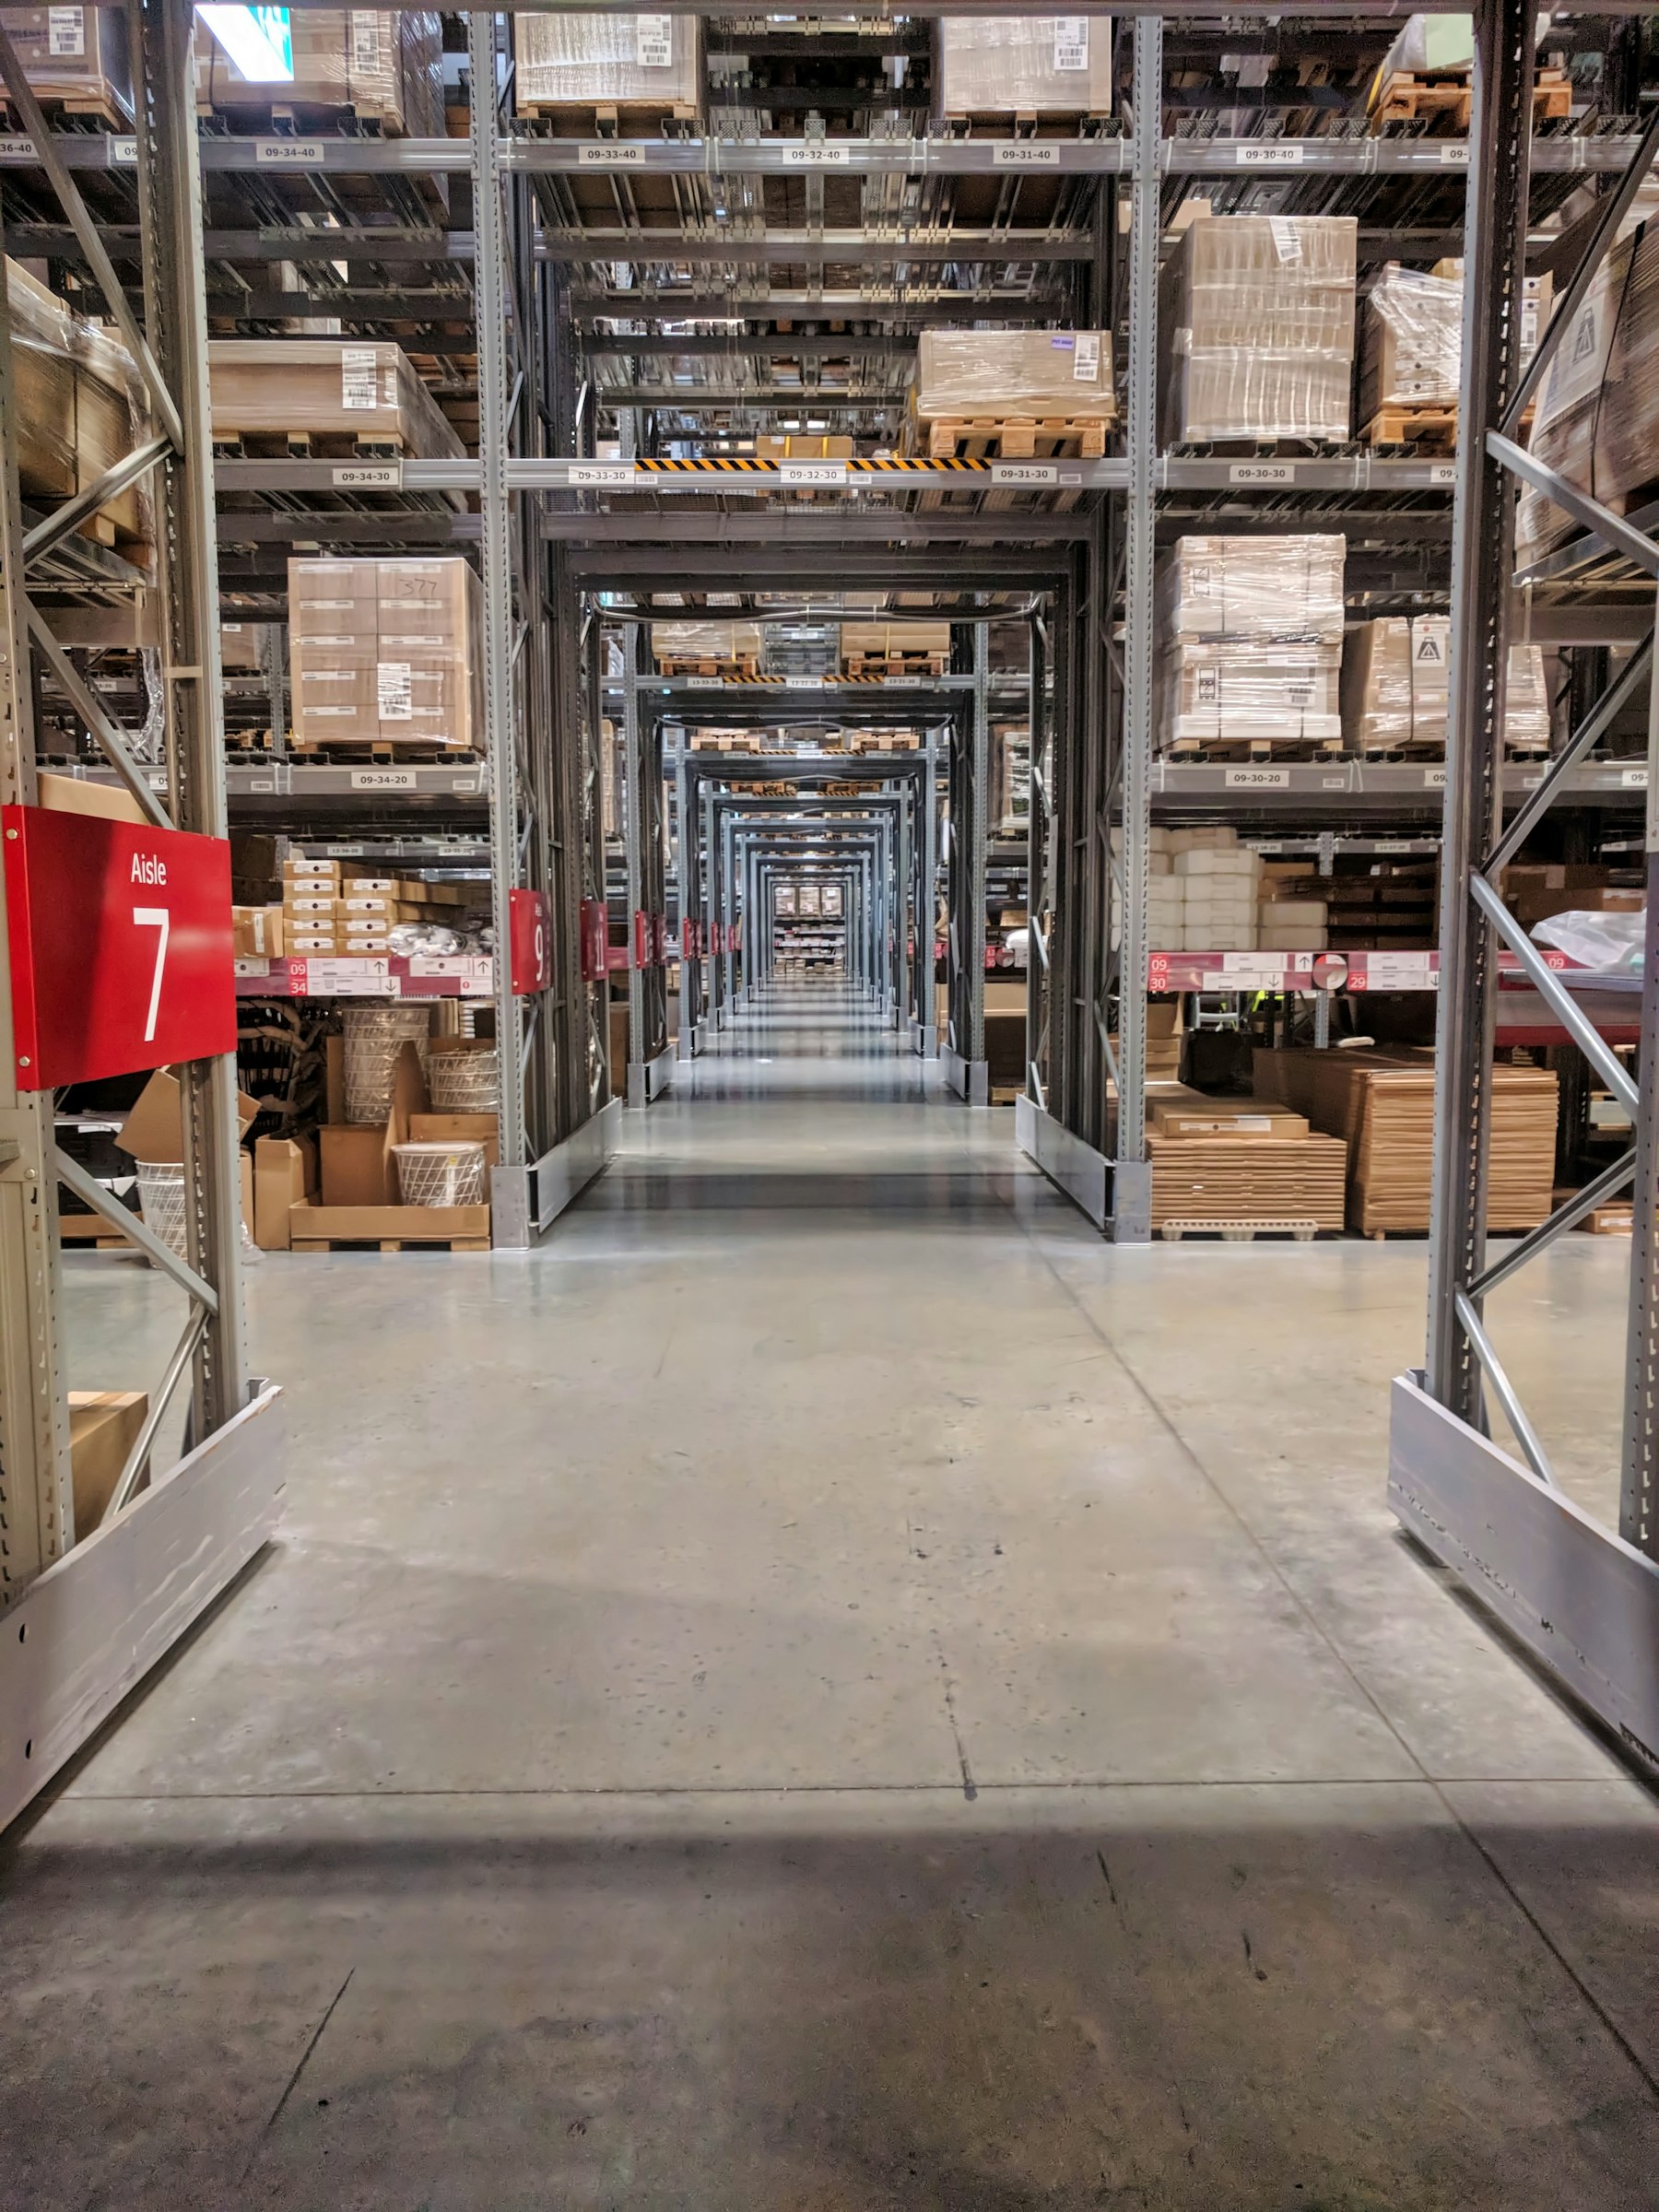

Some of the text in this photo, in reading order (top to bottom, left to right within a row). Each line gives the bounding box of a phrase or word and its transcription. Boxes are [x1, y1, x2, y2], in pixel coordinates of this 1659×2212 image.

[0, 144, 31, 153] 36-40
[265, 147, 315, 157] 09-34-40
[587, 150, 637, 159] 09-33-40
[792, 150, 841, 159] 09-32-40
[1002, 150, 1051, 159] 09-31-40
[1245, 150, 1294, 159] 09-30-40
[342, 472, 390, 481] 09-34-30
[578, 471, 626, 480] 09-33-30
[789, 470, 837, 479] 09-32-30
[1001, 469, 1048, 478] 09-31-30
[1238, 469, 1286, 478] 09-30-30
[398, 577, 437, 597] 377
[360, 775, 407, 784] 09-34-20
[1233, 773, 1281, 782] 09-30-20
[130, 852, 168, 886] Aisle
[535, 924, 544, 982] 9
[1151, 959, 1167, 971] 09
[1548, 958, 1564, 969] 09
[290, 963, 306, 976] 09
[133, 907, 170, 1042] 7
[1149, 977, 1166, 989] 30
[1349, 976, 1366, 989] 29
[290, 982, 306, 994] 34
